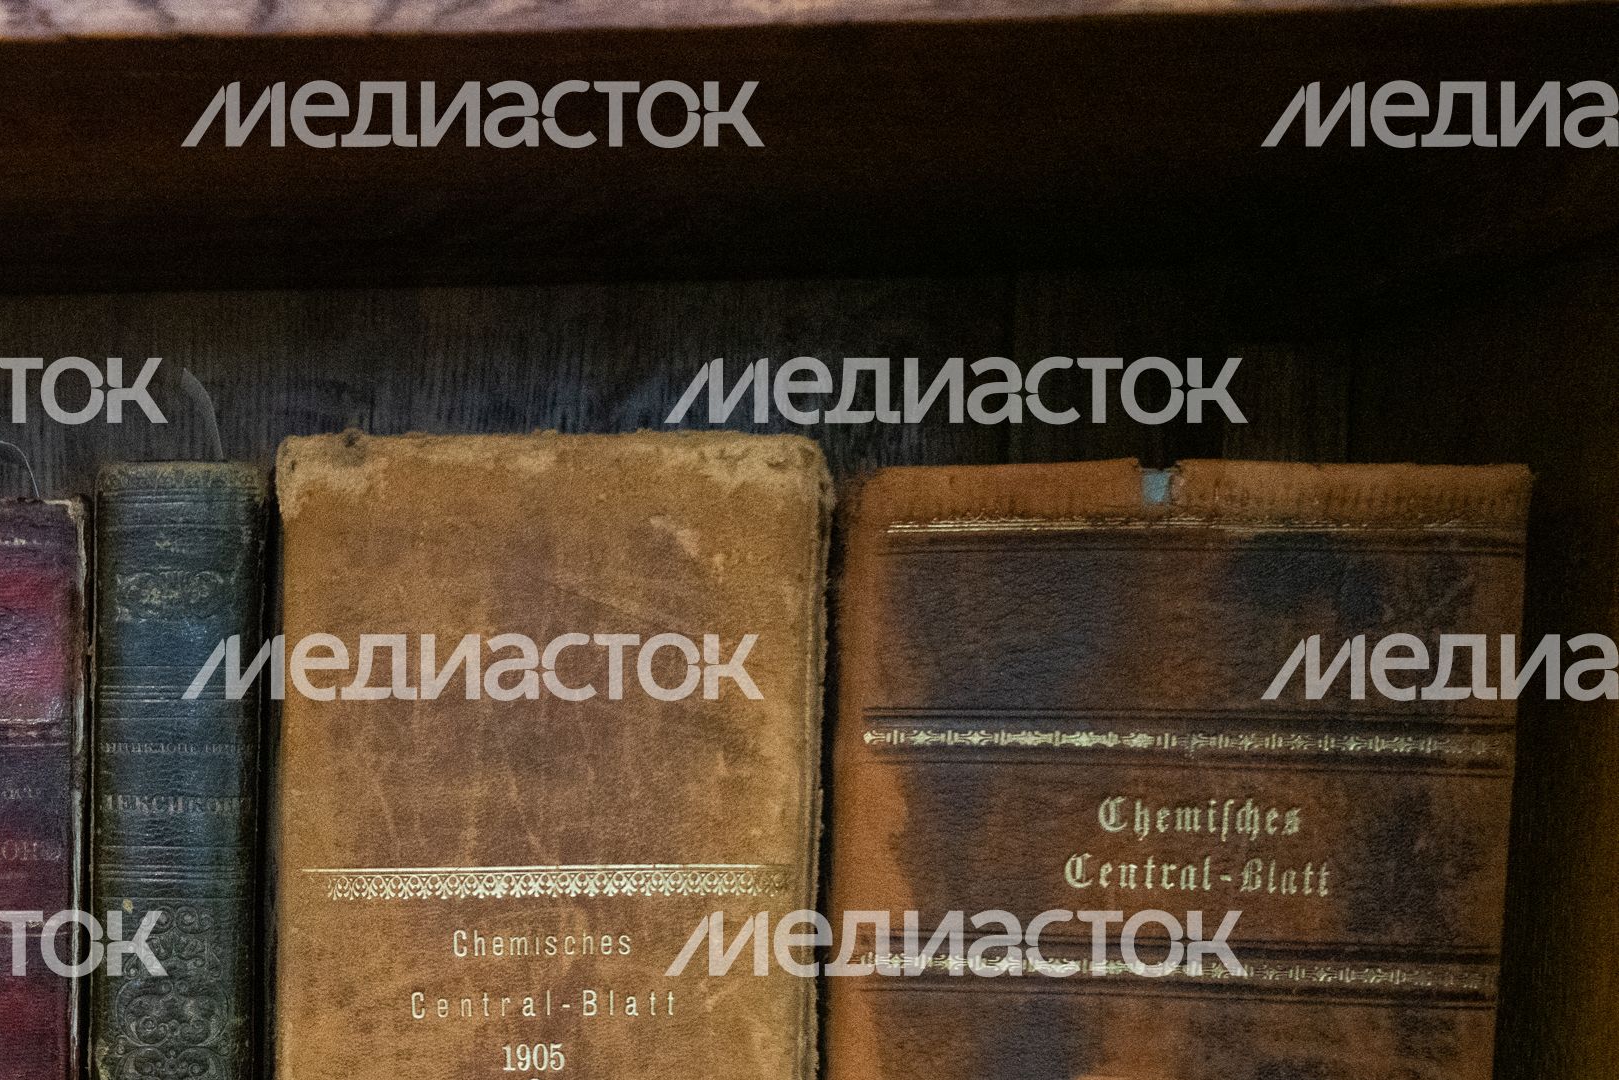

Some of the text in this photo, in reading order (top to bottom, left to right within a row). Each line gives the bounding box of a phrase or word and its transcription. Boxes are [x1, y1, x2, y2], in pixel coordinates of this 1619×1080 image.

[1064, 853, 1332, 897] Central-Blatt
[452, 930, 633, 958] Chemisches
[411, 989, 677, 1019] Central-Blatt
[501, 1043, 566, 1072] 1905
